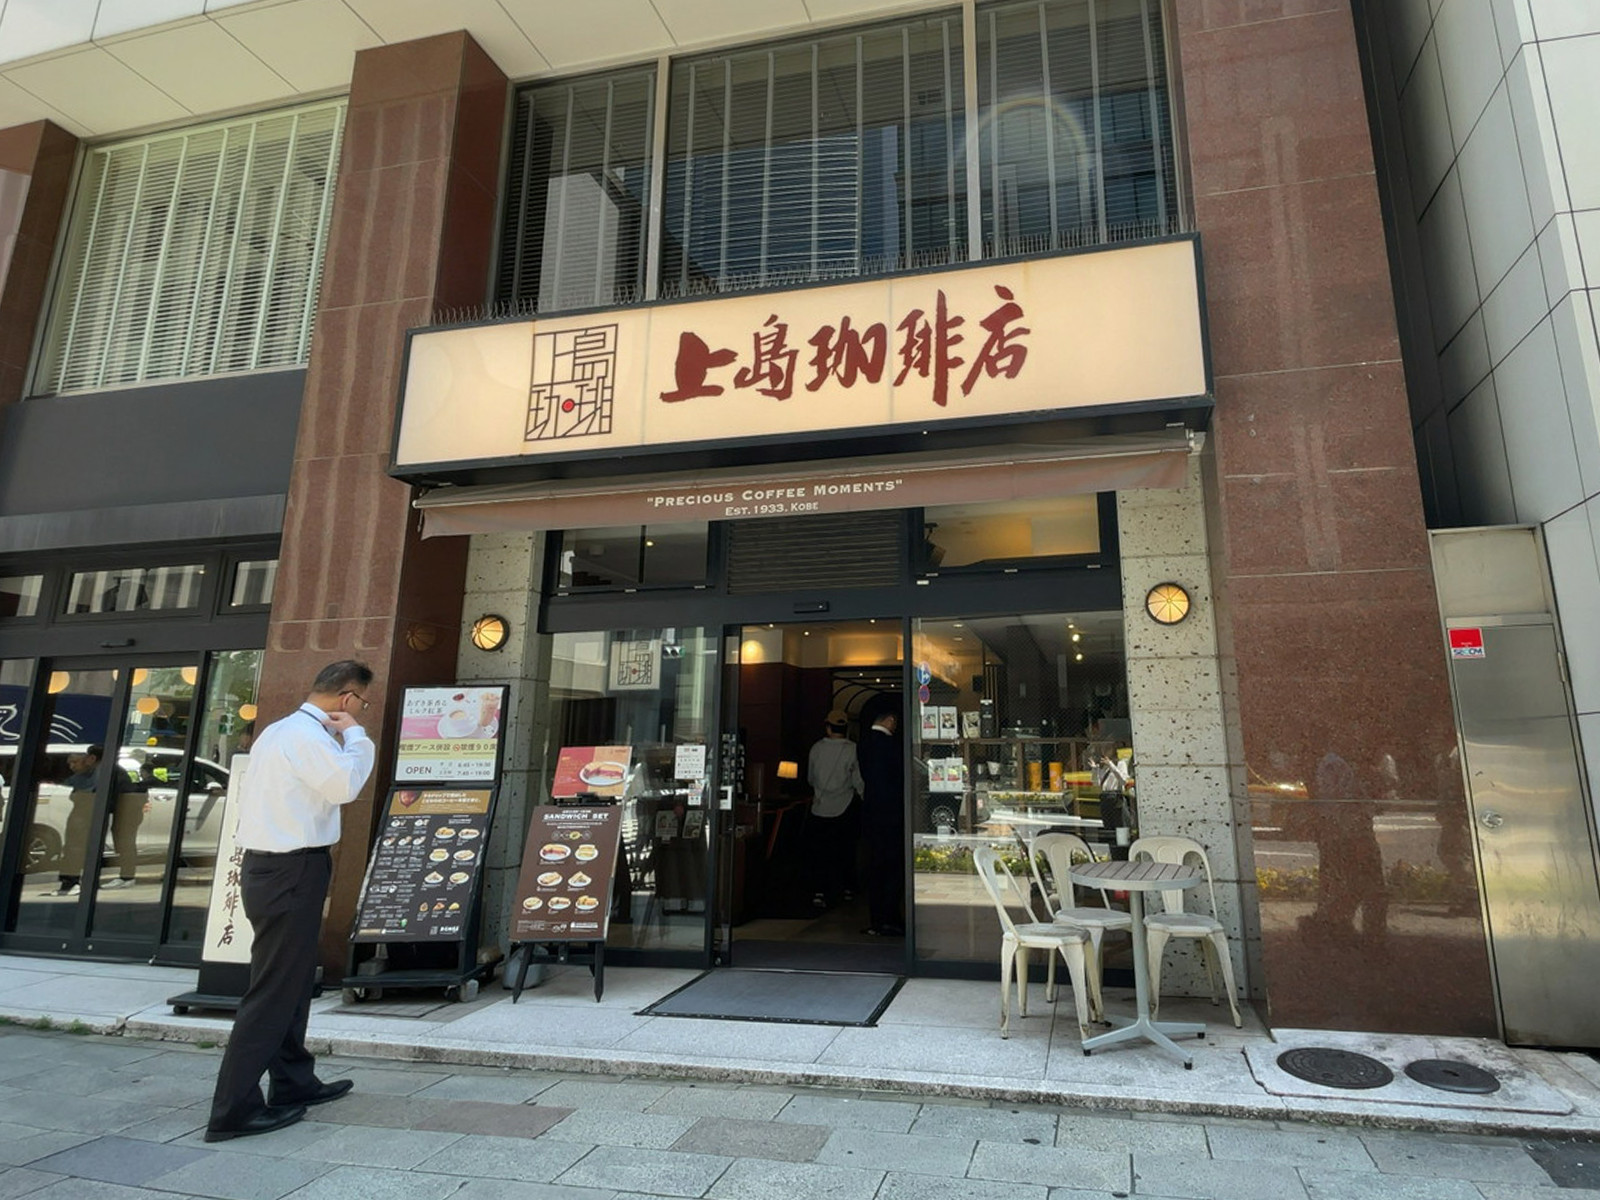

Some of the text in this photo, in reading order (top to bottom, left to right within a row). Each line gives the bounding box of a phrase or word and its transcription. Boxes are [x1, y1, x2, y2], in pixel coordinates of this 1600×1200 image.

[660, 284, 1031, 407] 上島珈琲店
[647, 479, 903, 507] "PRECIOUS COFFEE MOMENTS"
[725, 506, 751, 516] EST.
[791, 501, 819, 512] KOBE
[1453, 647, 1483, 656] SECOM
[405, 766, 433, 775] OPEN
[592, 812, 609, 820] SET
